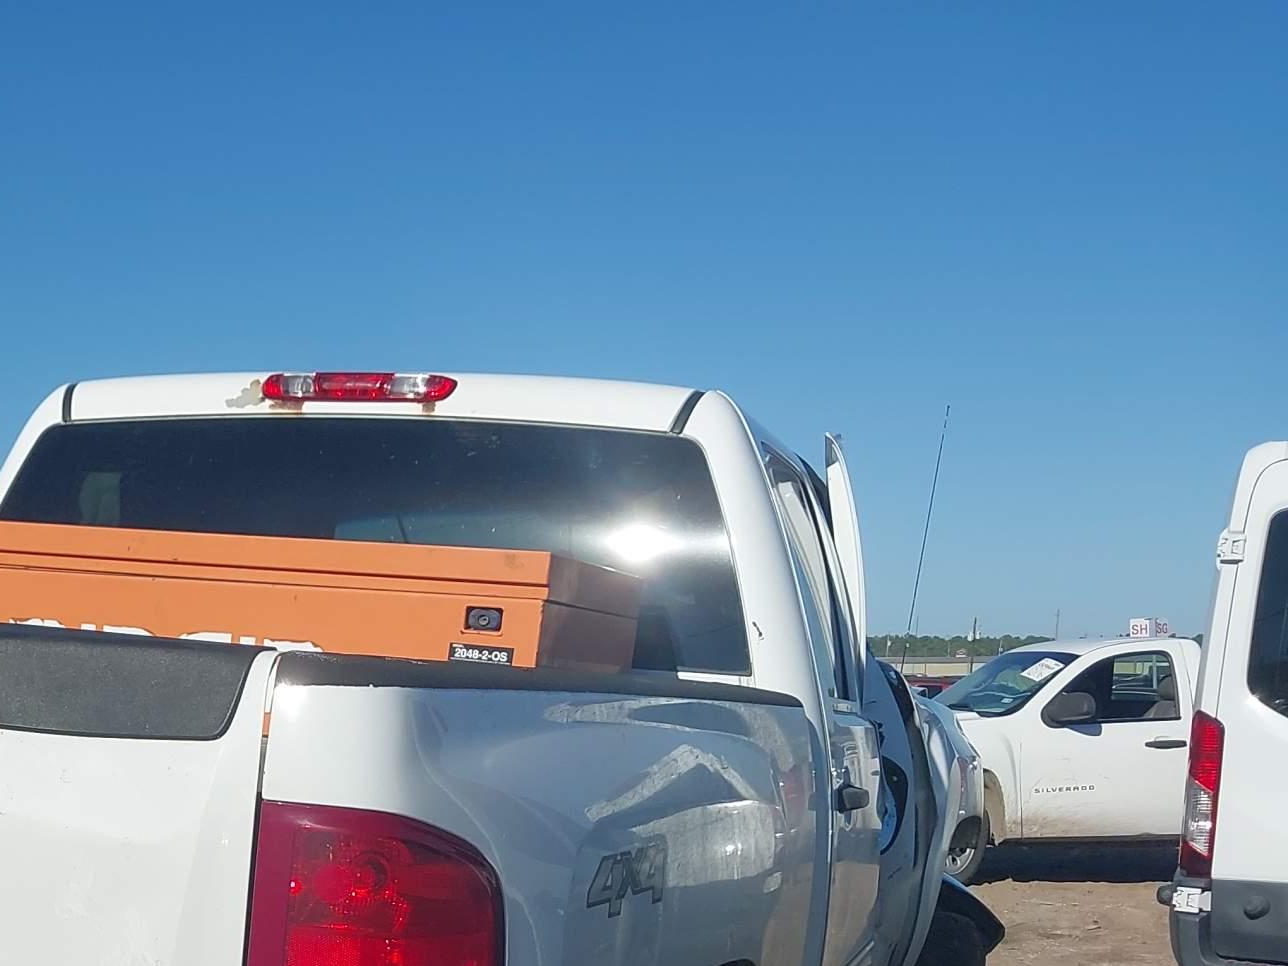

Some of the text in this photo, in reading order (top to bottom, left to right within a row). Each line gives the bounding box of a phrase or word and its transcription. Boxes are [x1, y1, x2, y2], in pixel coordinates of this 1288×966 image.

[1131, 623, 1148, 635] SH
[453, 647, 509, 662] 2048-2-OS
[1033, 784, 1095, 793] SILVERADO
